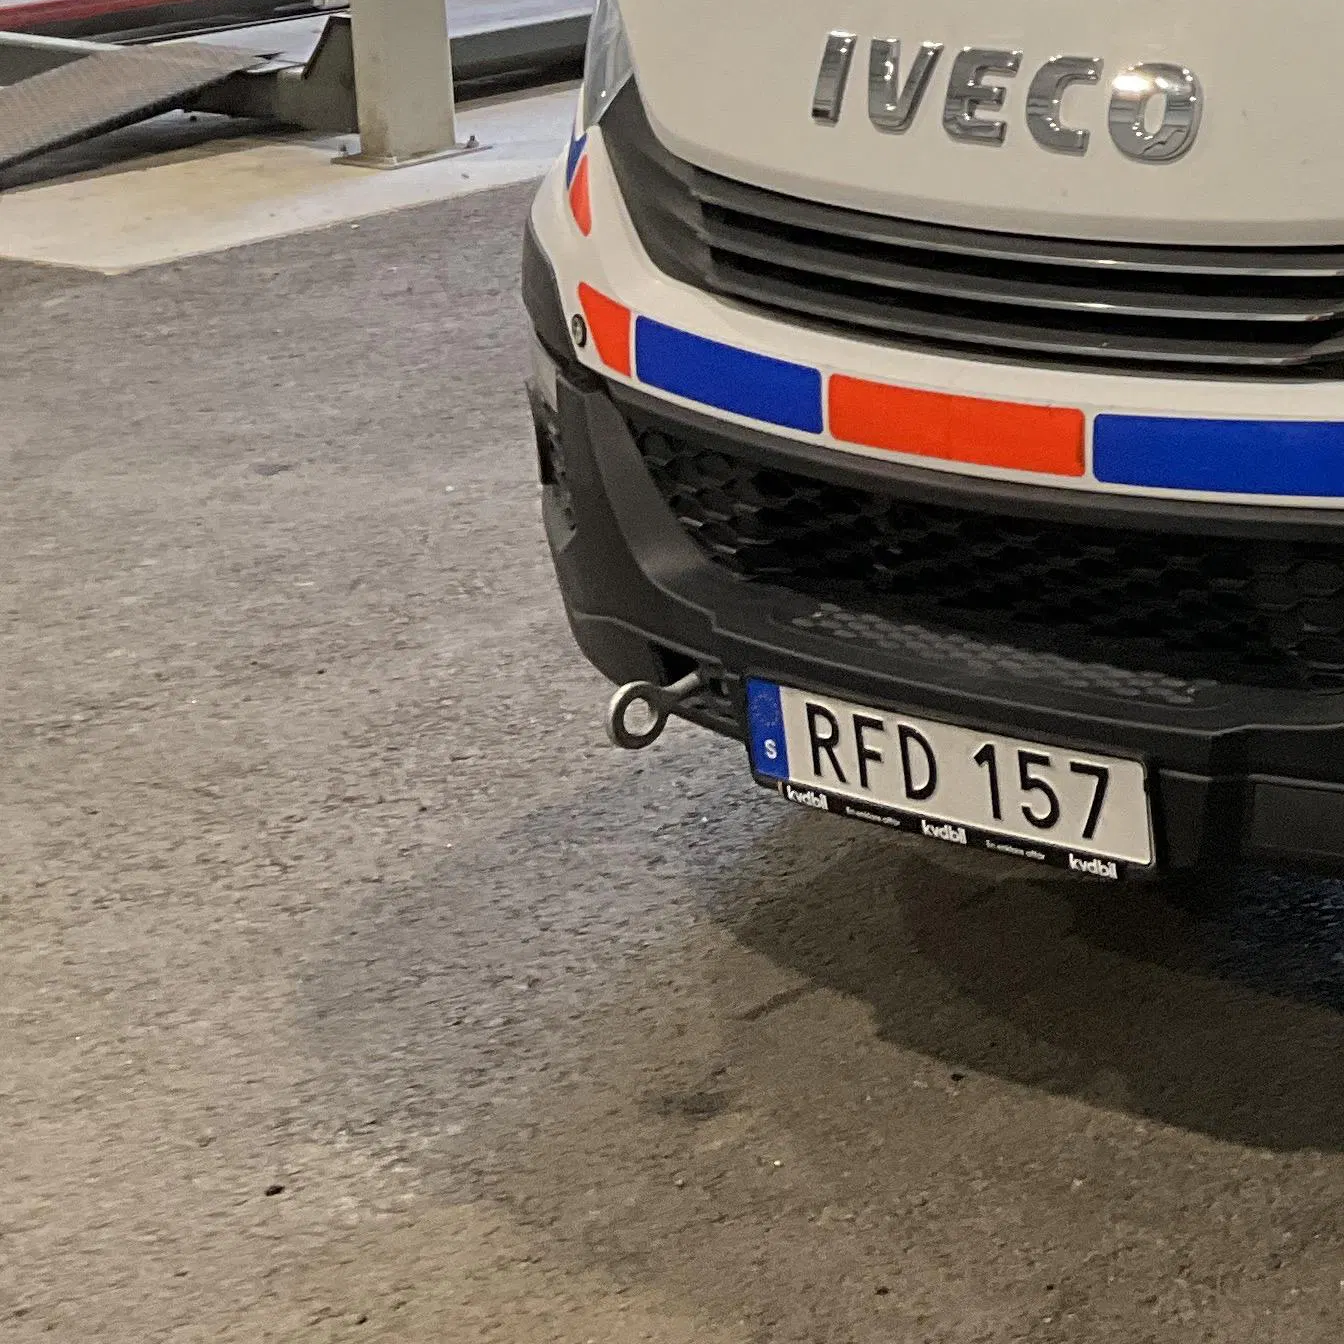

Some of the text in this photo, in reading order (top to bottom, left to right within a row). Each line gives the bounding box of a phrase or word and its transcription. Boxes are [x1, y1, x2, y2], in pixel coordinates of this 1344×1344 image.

[811, 29, 1204, 166] IVECO
[763, 738, 778, 760] S
[805, 702, 1109, 840] RFD 157
[1068, 852, 1119, 880] kvdbil
